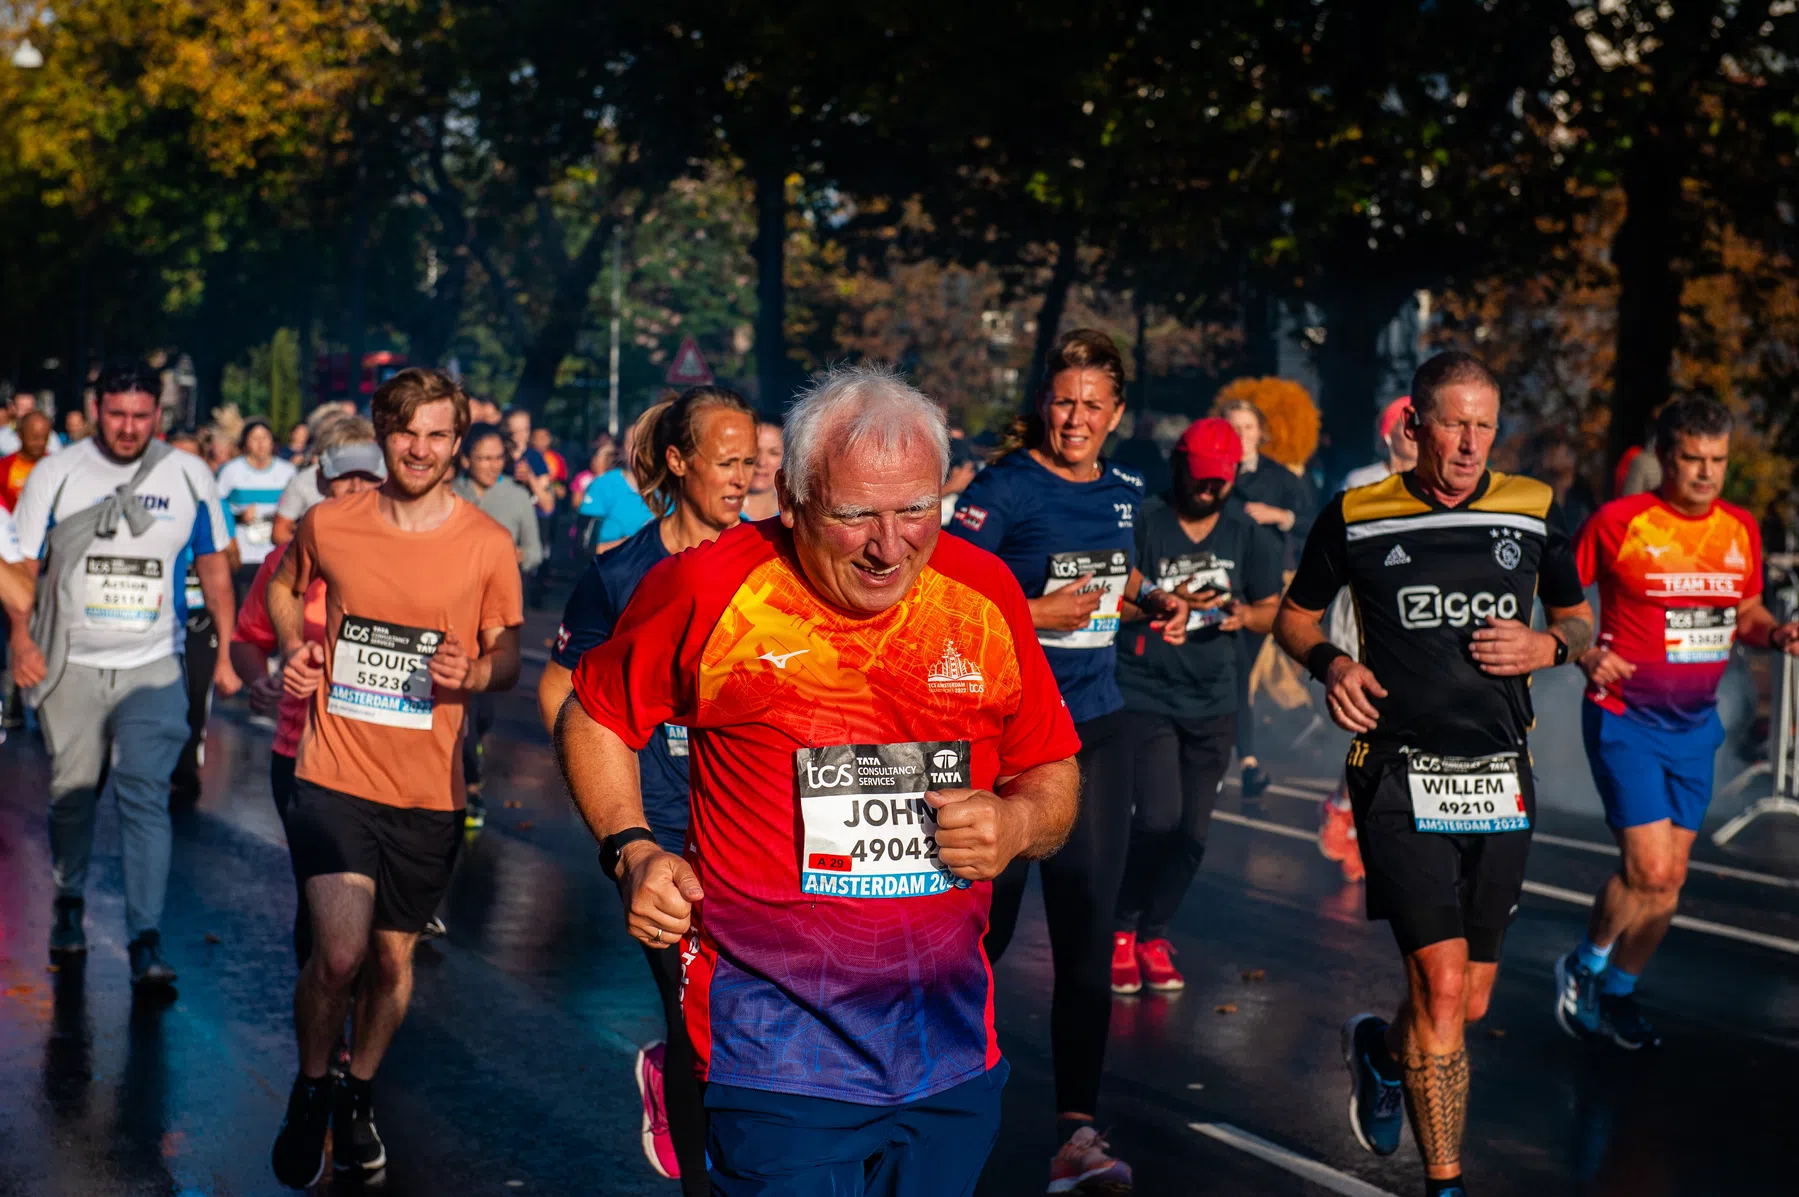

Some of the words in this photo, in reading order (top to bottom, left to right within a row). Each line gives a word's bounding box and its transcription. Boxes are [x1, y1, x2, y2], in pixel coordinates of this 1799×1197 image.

[1052, 560, 1078, 577] tcs
[1662, 578, 1705, 592] TEAM
[1708, 578, 1734, 592] TCS
[344, 620, 370, 642] tcs
[357, 648, 418, 674] LOUIS
[356, 671, 411, 693] 55236
[969, 682, 984, 693] tcs
[331, 686, 400, 711] AMSTERDAM
[857, 757, 881, 766] TATA
[1489, 762, 1511, 771] TATA
[807, 761, 854, 789] tcs
[858, 765, 917, 776] CONSULTANCY
[930, 772, 963, 783] TATA
[859, 777, 896, 786] SERVICES
[1422, 778, 1504, 795] WILLEM
[1439, 801, 1495, 815] 49210
[1418, 819, 1491, 831] AMSTERDAM
[1494, 817, 1526, 831] 2022
[850, 836, 937, 862] 49042
[817, 858, 827, 868] A
[830, 858, 844, 869] 29
[804, 873, 926, 896] AMSTERDAM
